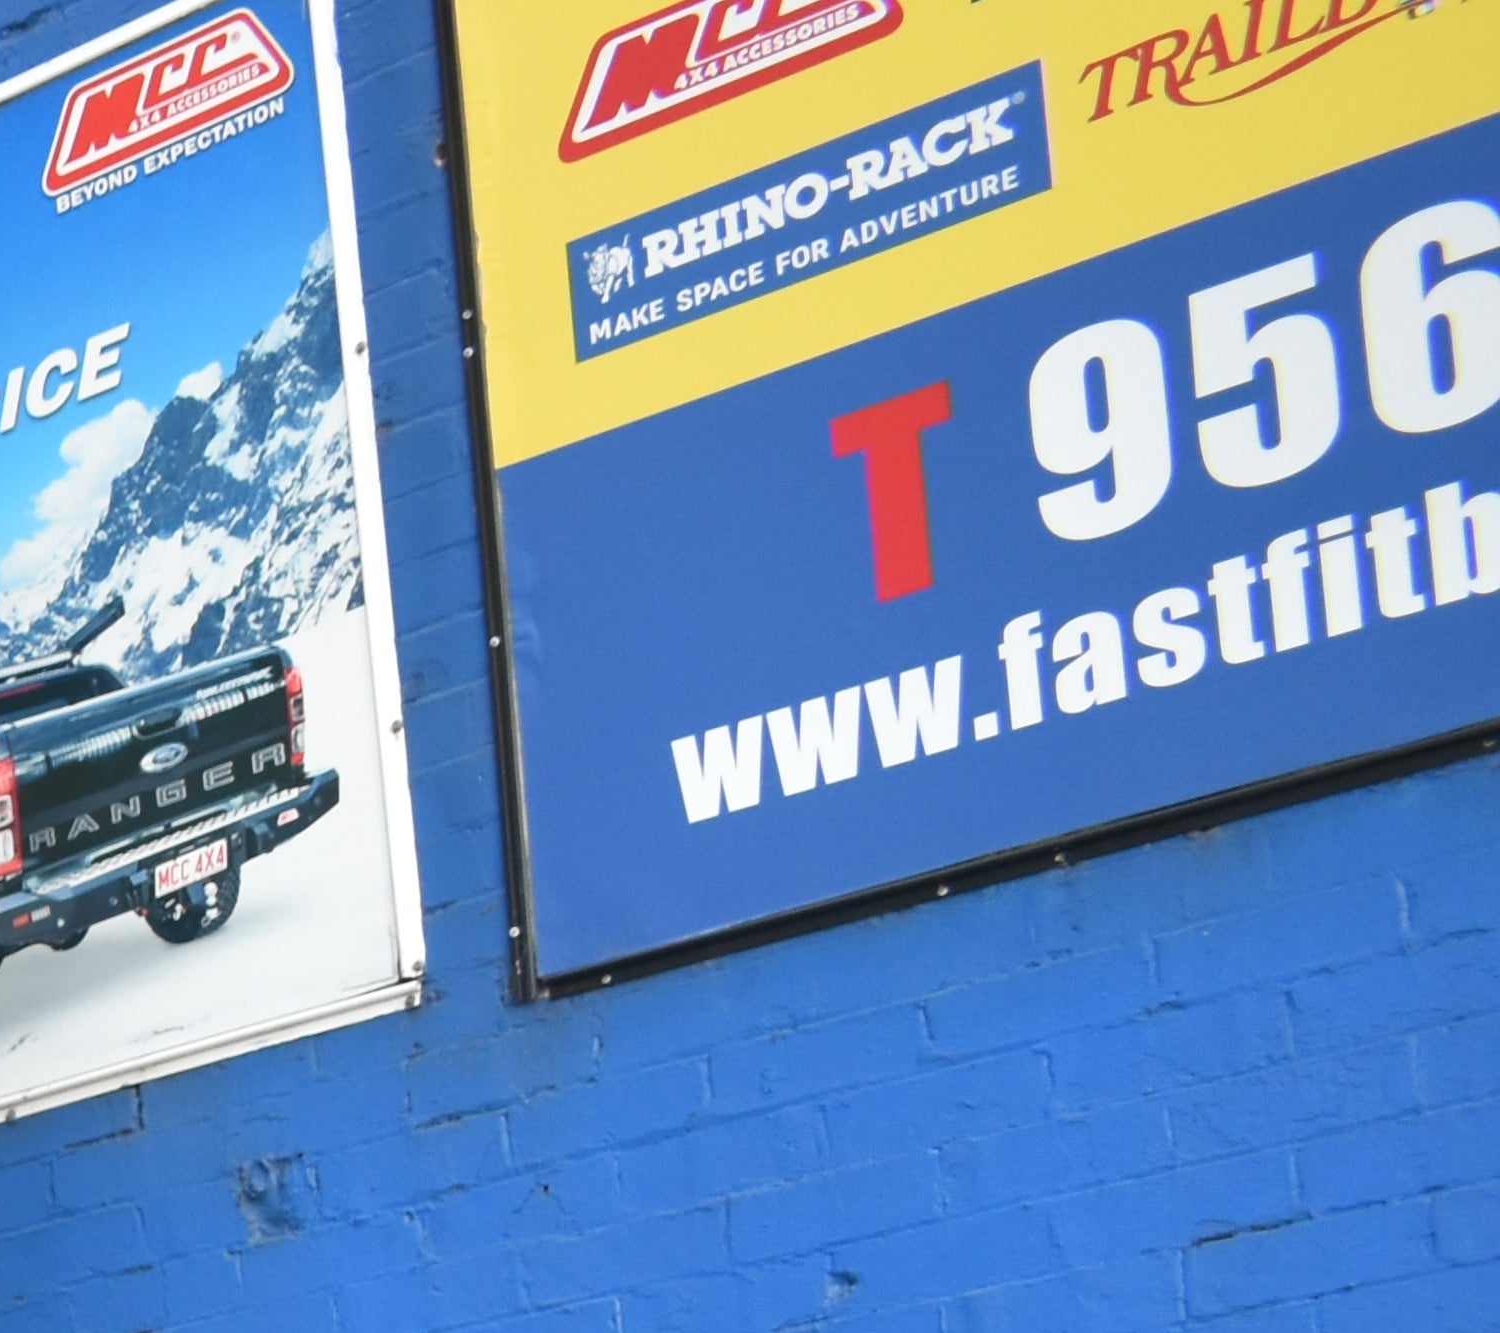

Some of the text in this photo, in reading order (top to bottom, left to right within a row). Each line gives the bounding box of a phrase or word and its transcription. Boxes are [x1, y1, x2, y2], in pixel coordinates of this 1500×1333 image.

[64, 33, 264, 165] MCC
[128, 64, 262, 133] 4X4 ACCESSORIES
[674, 4, 860, 90] 4X4 ACCESSORIES
[55, 97, 285, 214] BEYOND EXPECTATION
[642, 98, 1016, 279] RHINO-RACK
[589, 165, 1020, 346] MAKE SPACE FOR ADVENTURE
[829, 200, 1500, 603] T 956
[670, 480, 1500, 825] www.fastfitb
[29, 742, 286, 853] RANGER
[158, 844, 225, 891] MCC 4X4
